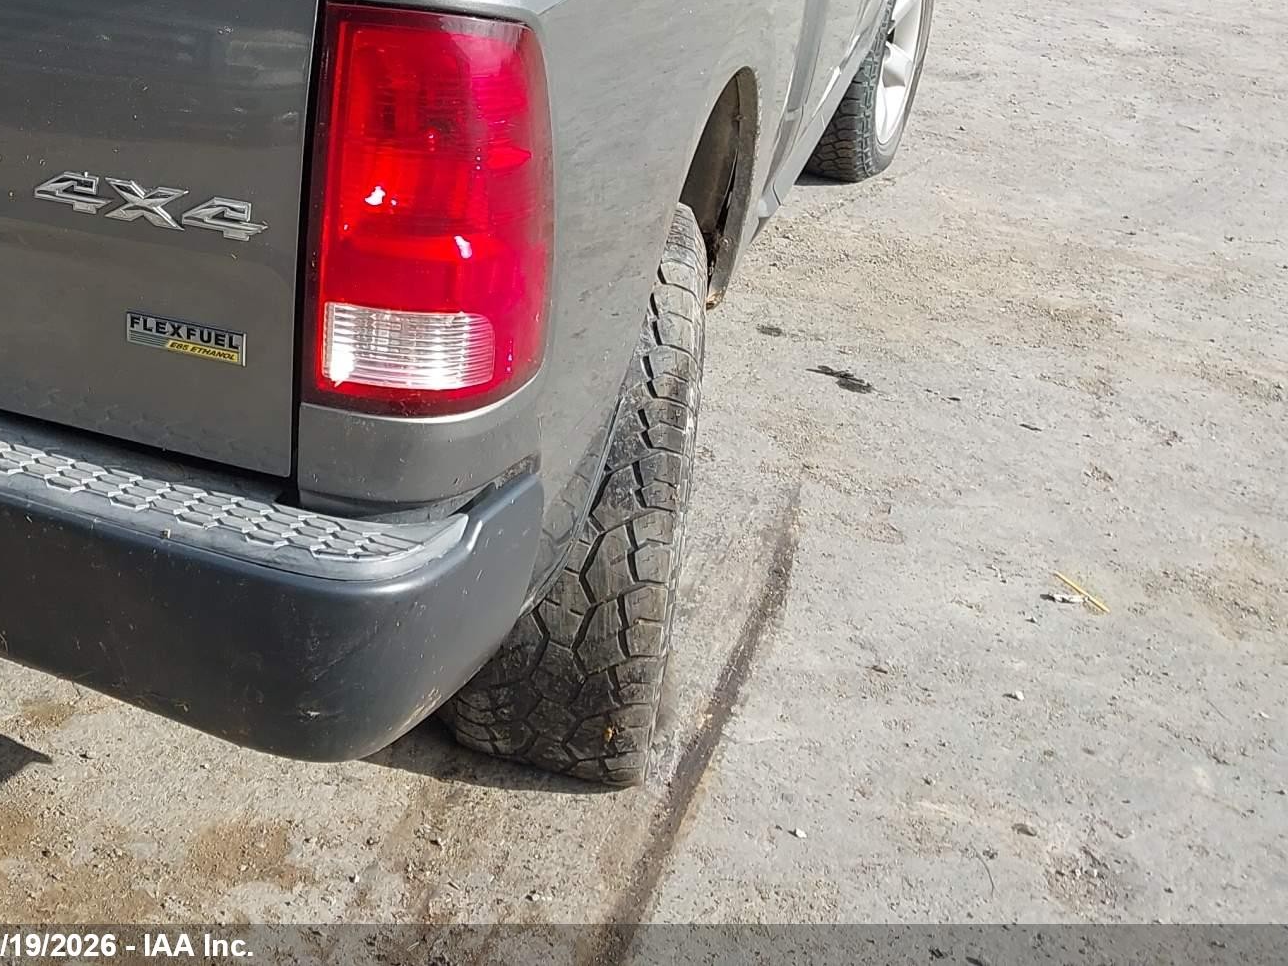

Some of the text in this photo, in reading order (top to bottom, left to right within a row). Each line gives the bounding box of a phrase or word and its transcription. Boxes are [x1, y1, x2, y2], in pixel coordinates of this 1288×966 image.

[129, 315, 240, 349] FLEXFUEL
[169, 341, 236, 361] E85 ETHANOL
